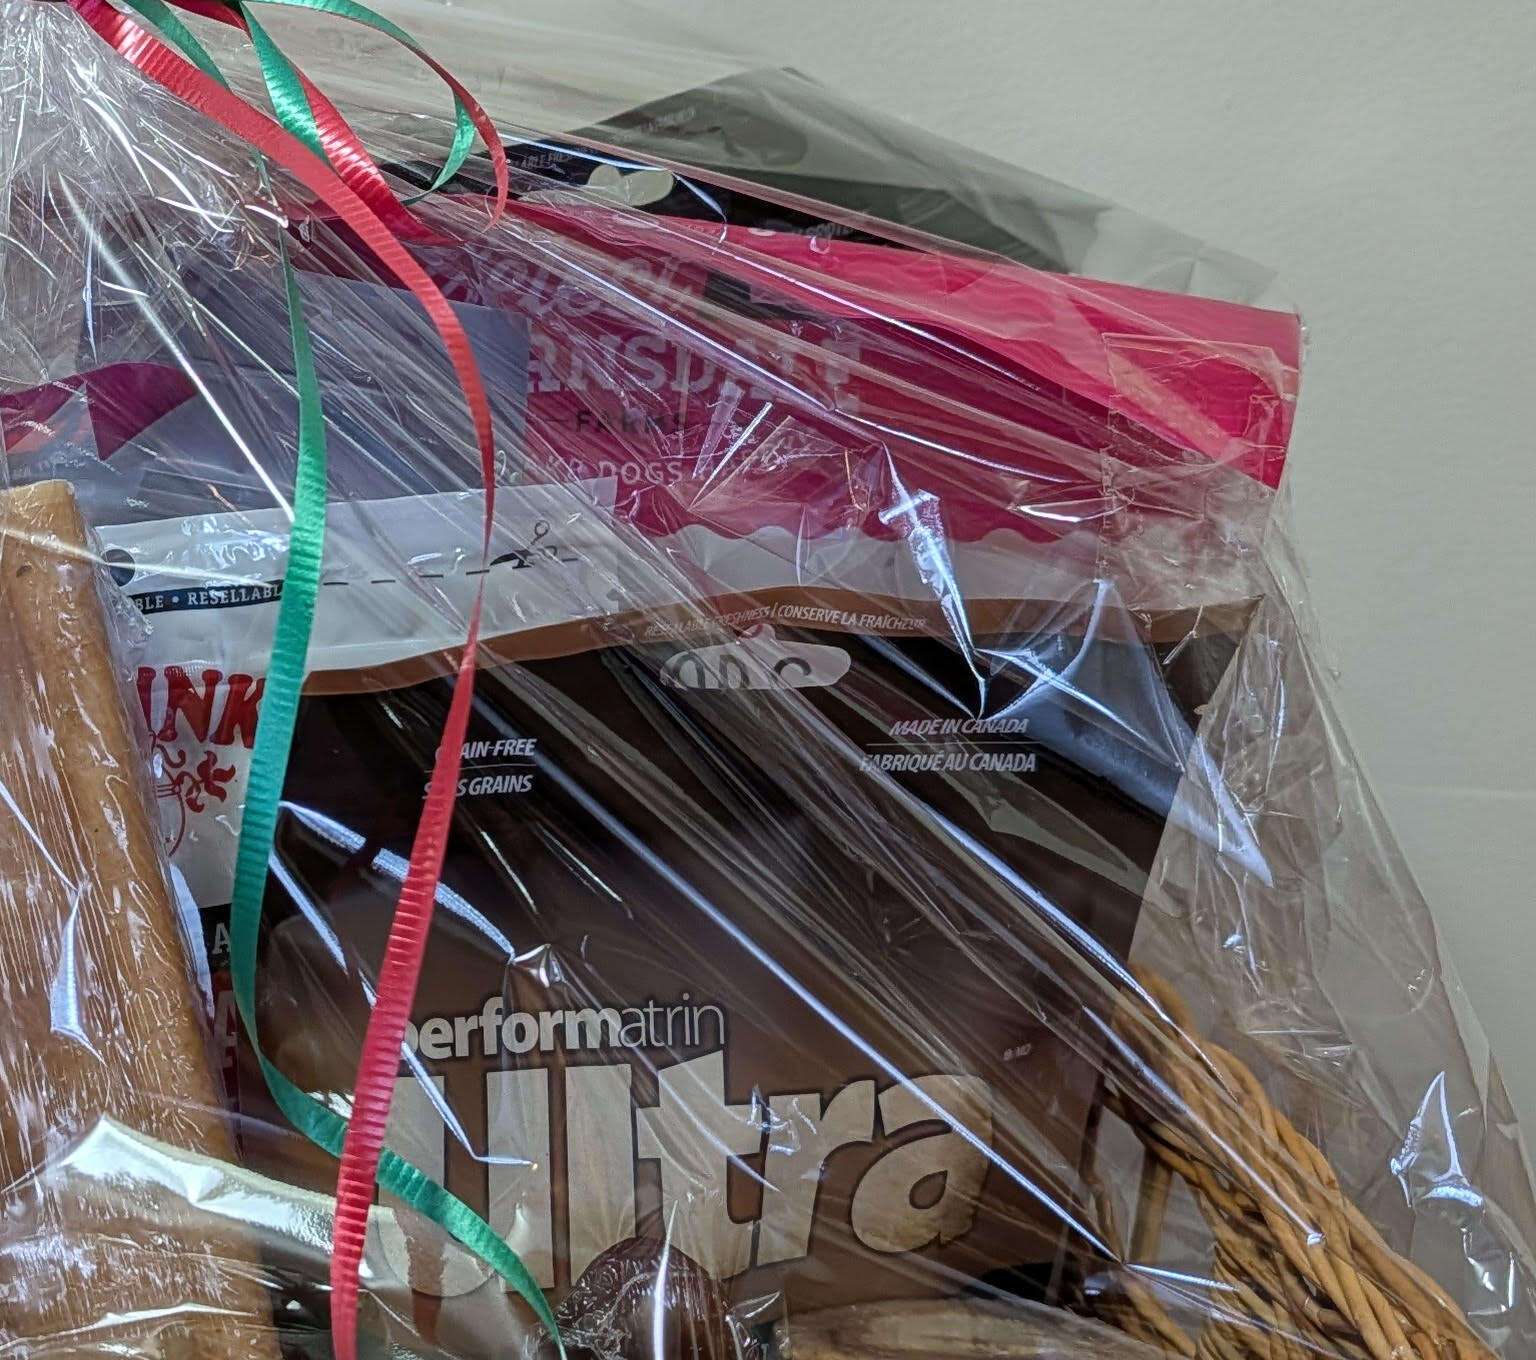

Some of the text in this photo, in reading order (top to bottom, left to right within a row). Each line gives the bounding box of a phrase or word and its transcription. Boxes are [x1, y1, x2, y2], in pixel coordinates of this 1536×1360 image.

[598, 460, 684, 485] DOGS
[777, 604, 841, 625] CONSERVE
[840, 611, 859, 627] LA
[889, 717, 1031, 736] MADE IN CANADA
[434, 738, 538, 761] AIN-FREE
[860, 749, 1038, 773] FABRIQUÉ AU CANADA
[468, 773, 535, 797] GRAINS
[401, 991, 726, 1061] erformatrin
[372, 1049, 993, 1300] Ultra
